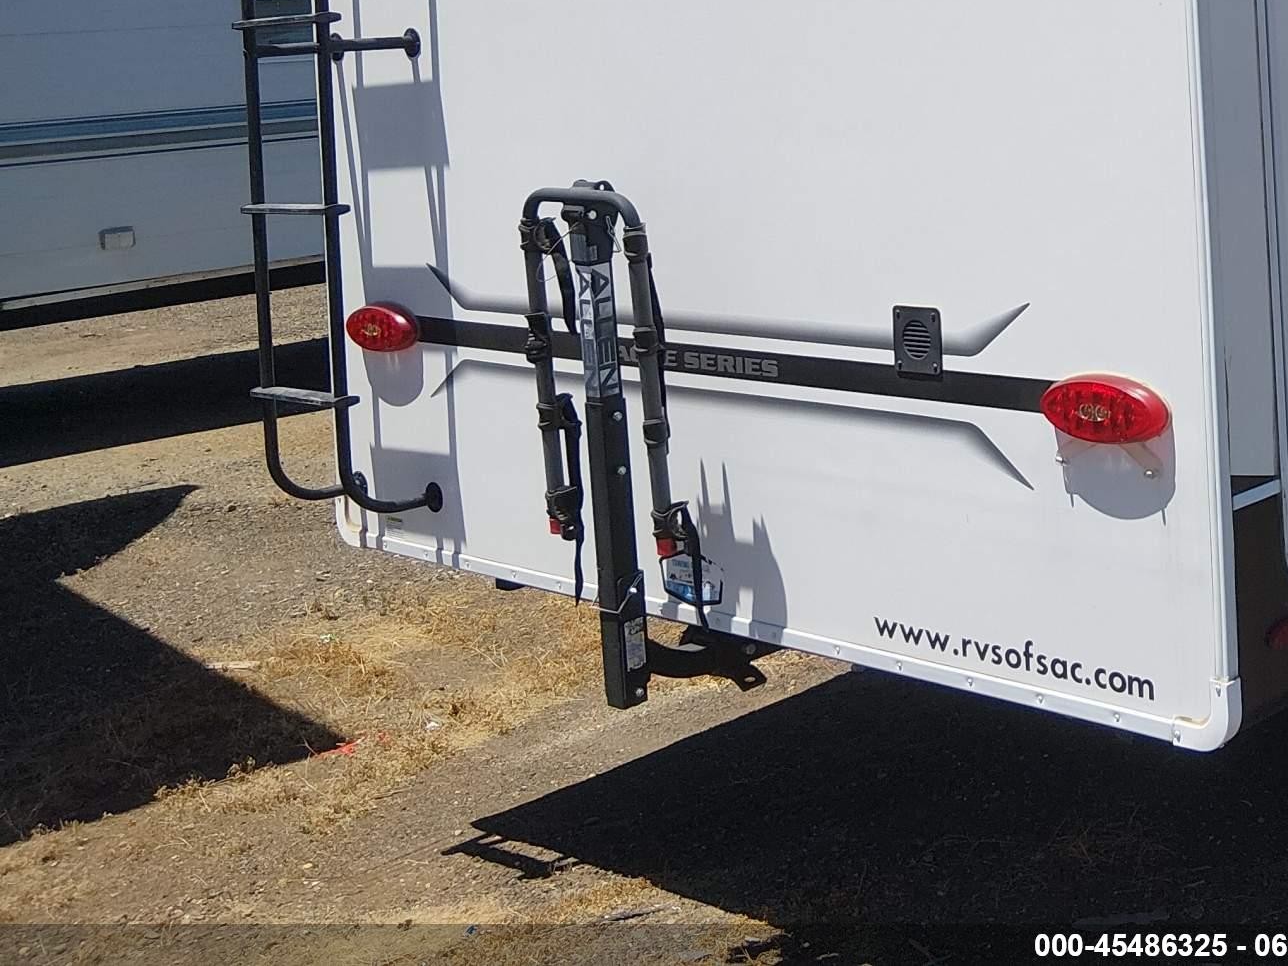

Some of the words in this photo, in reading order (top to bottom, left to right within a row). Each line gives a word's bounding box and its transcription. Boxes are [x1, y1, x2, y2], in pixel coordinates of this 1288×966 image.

[591, 268, 619, 391] ALLEN
[683, 351, 779, 378] SERIES
[873, 616, 1155, 701] www.rvsofsac.com
